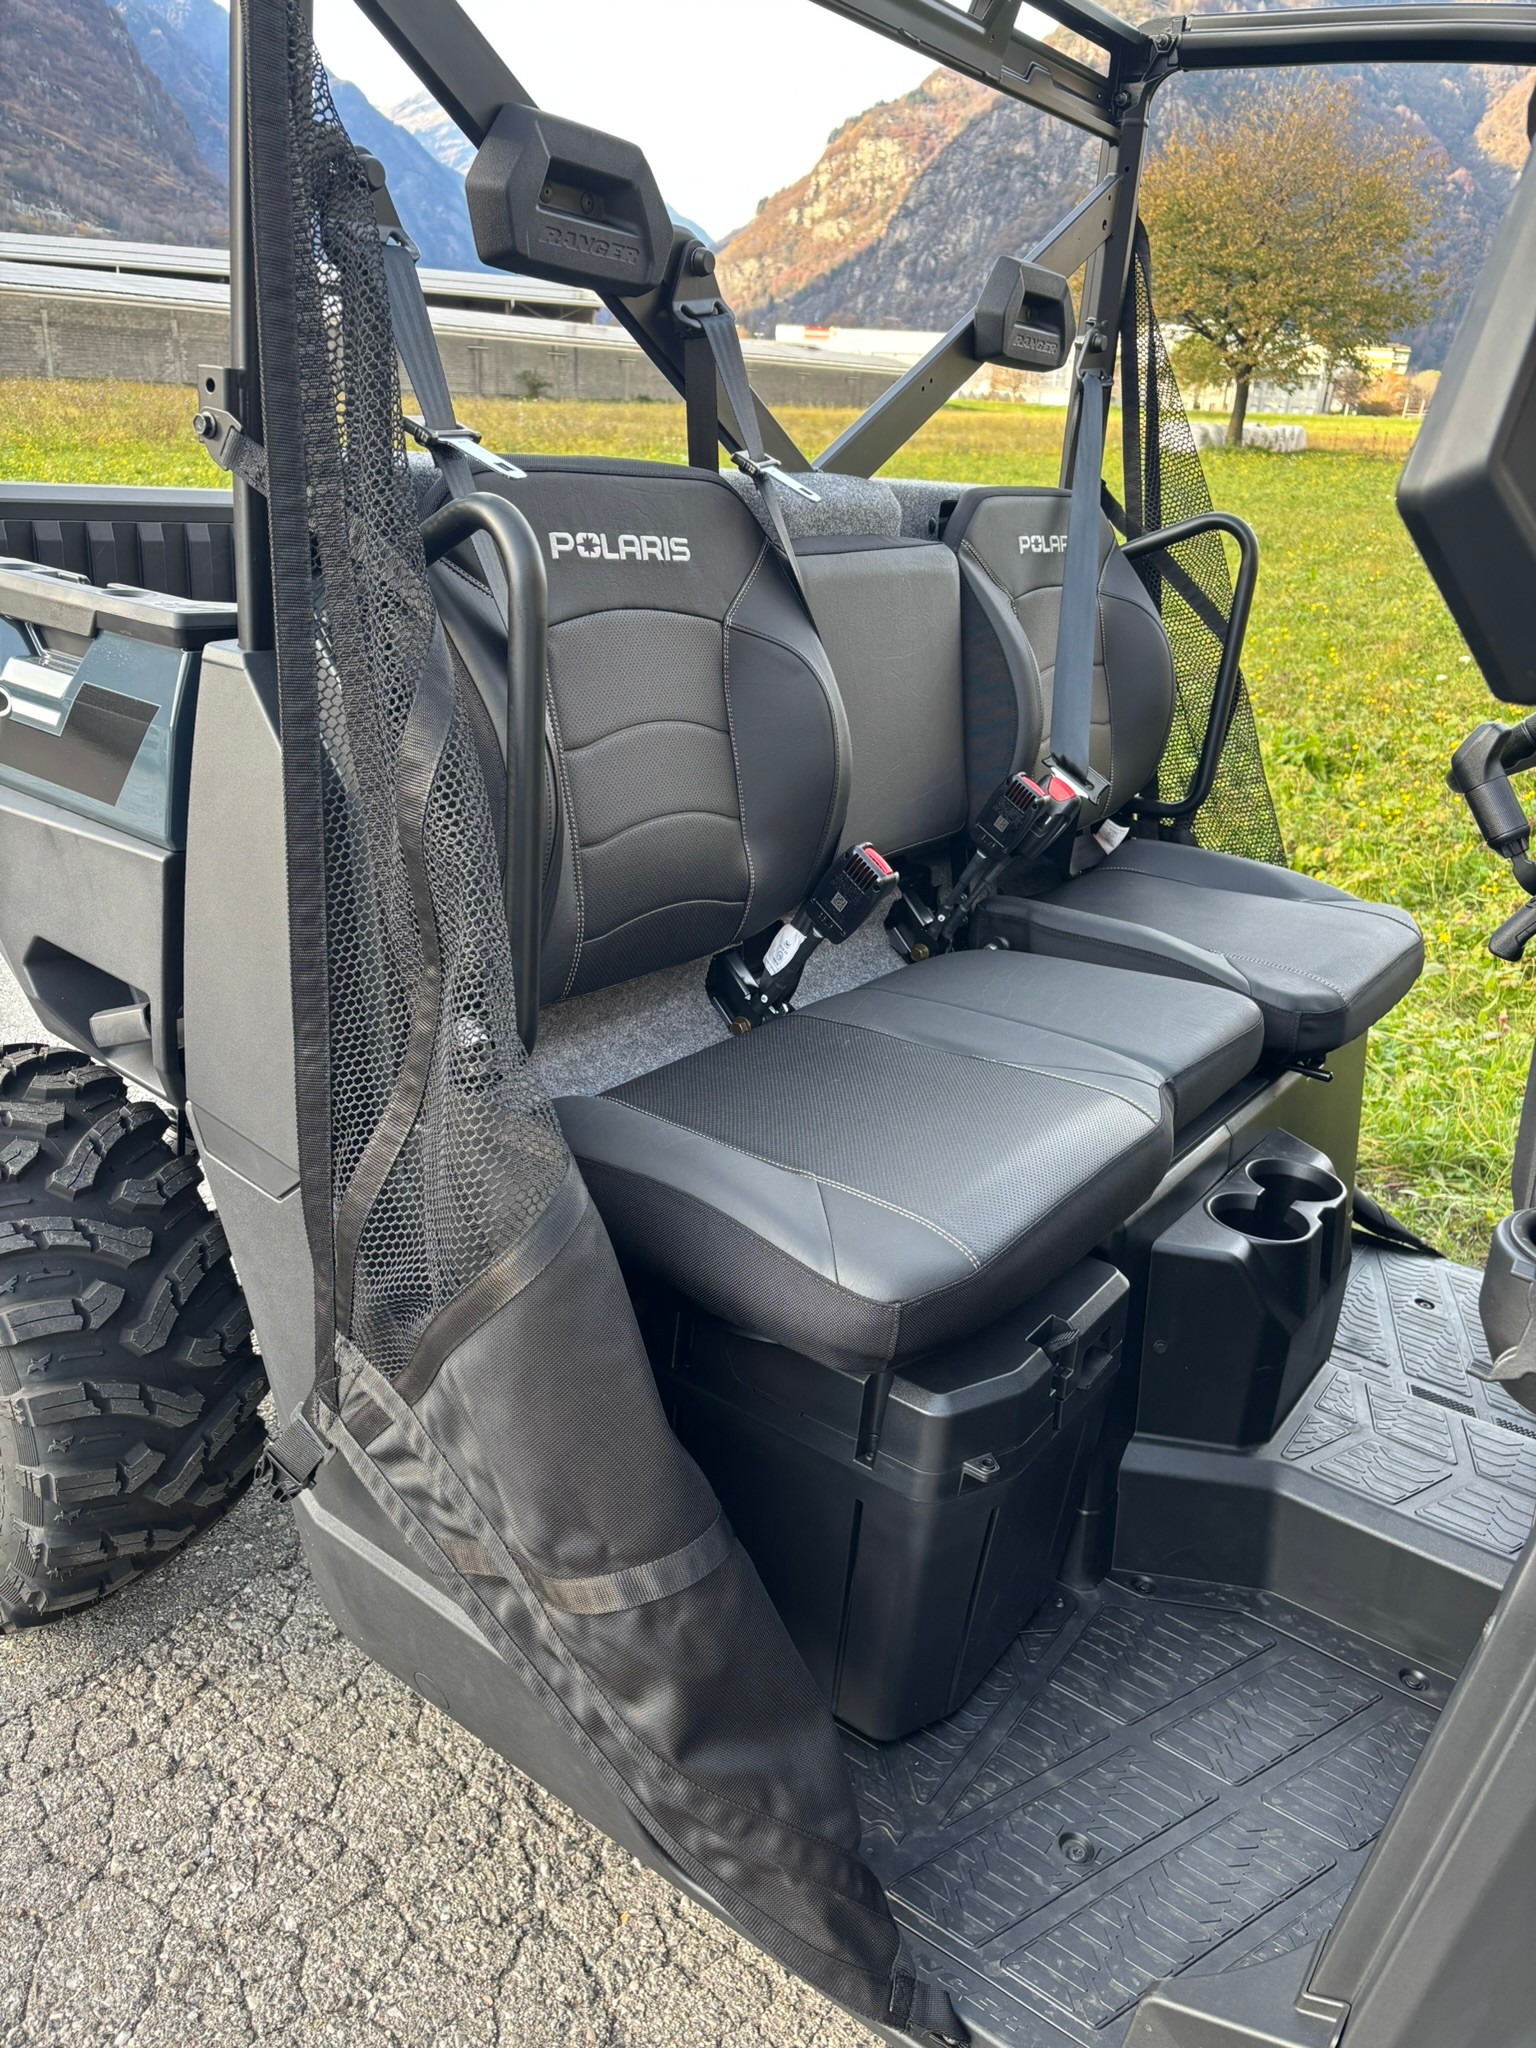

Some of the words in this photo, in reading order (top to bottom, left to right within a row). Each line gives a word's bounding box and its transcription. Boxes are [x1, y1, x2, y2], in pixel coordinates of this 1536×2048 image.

[538, 224, 641, 266] RANGER
[1012, 333, 1059, 355] RANGER
[548, 531, 692, 562] POLARIS
[1018, 534, 1068, 555] POLAR
[913, 1953, 1029, 2033] NGER
